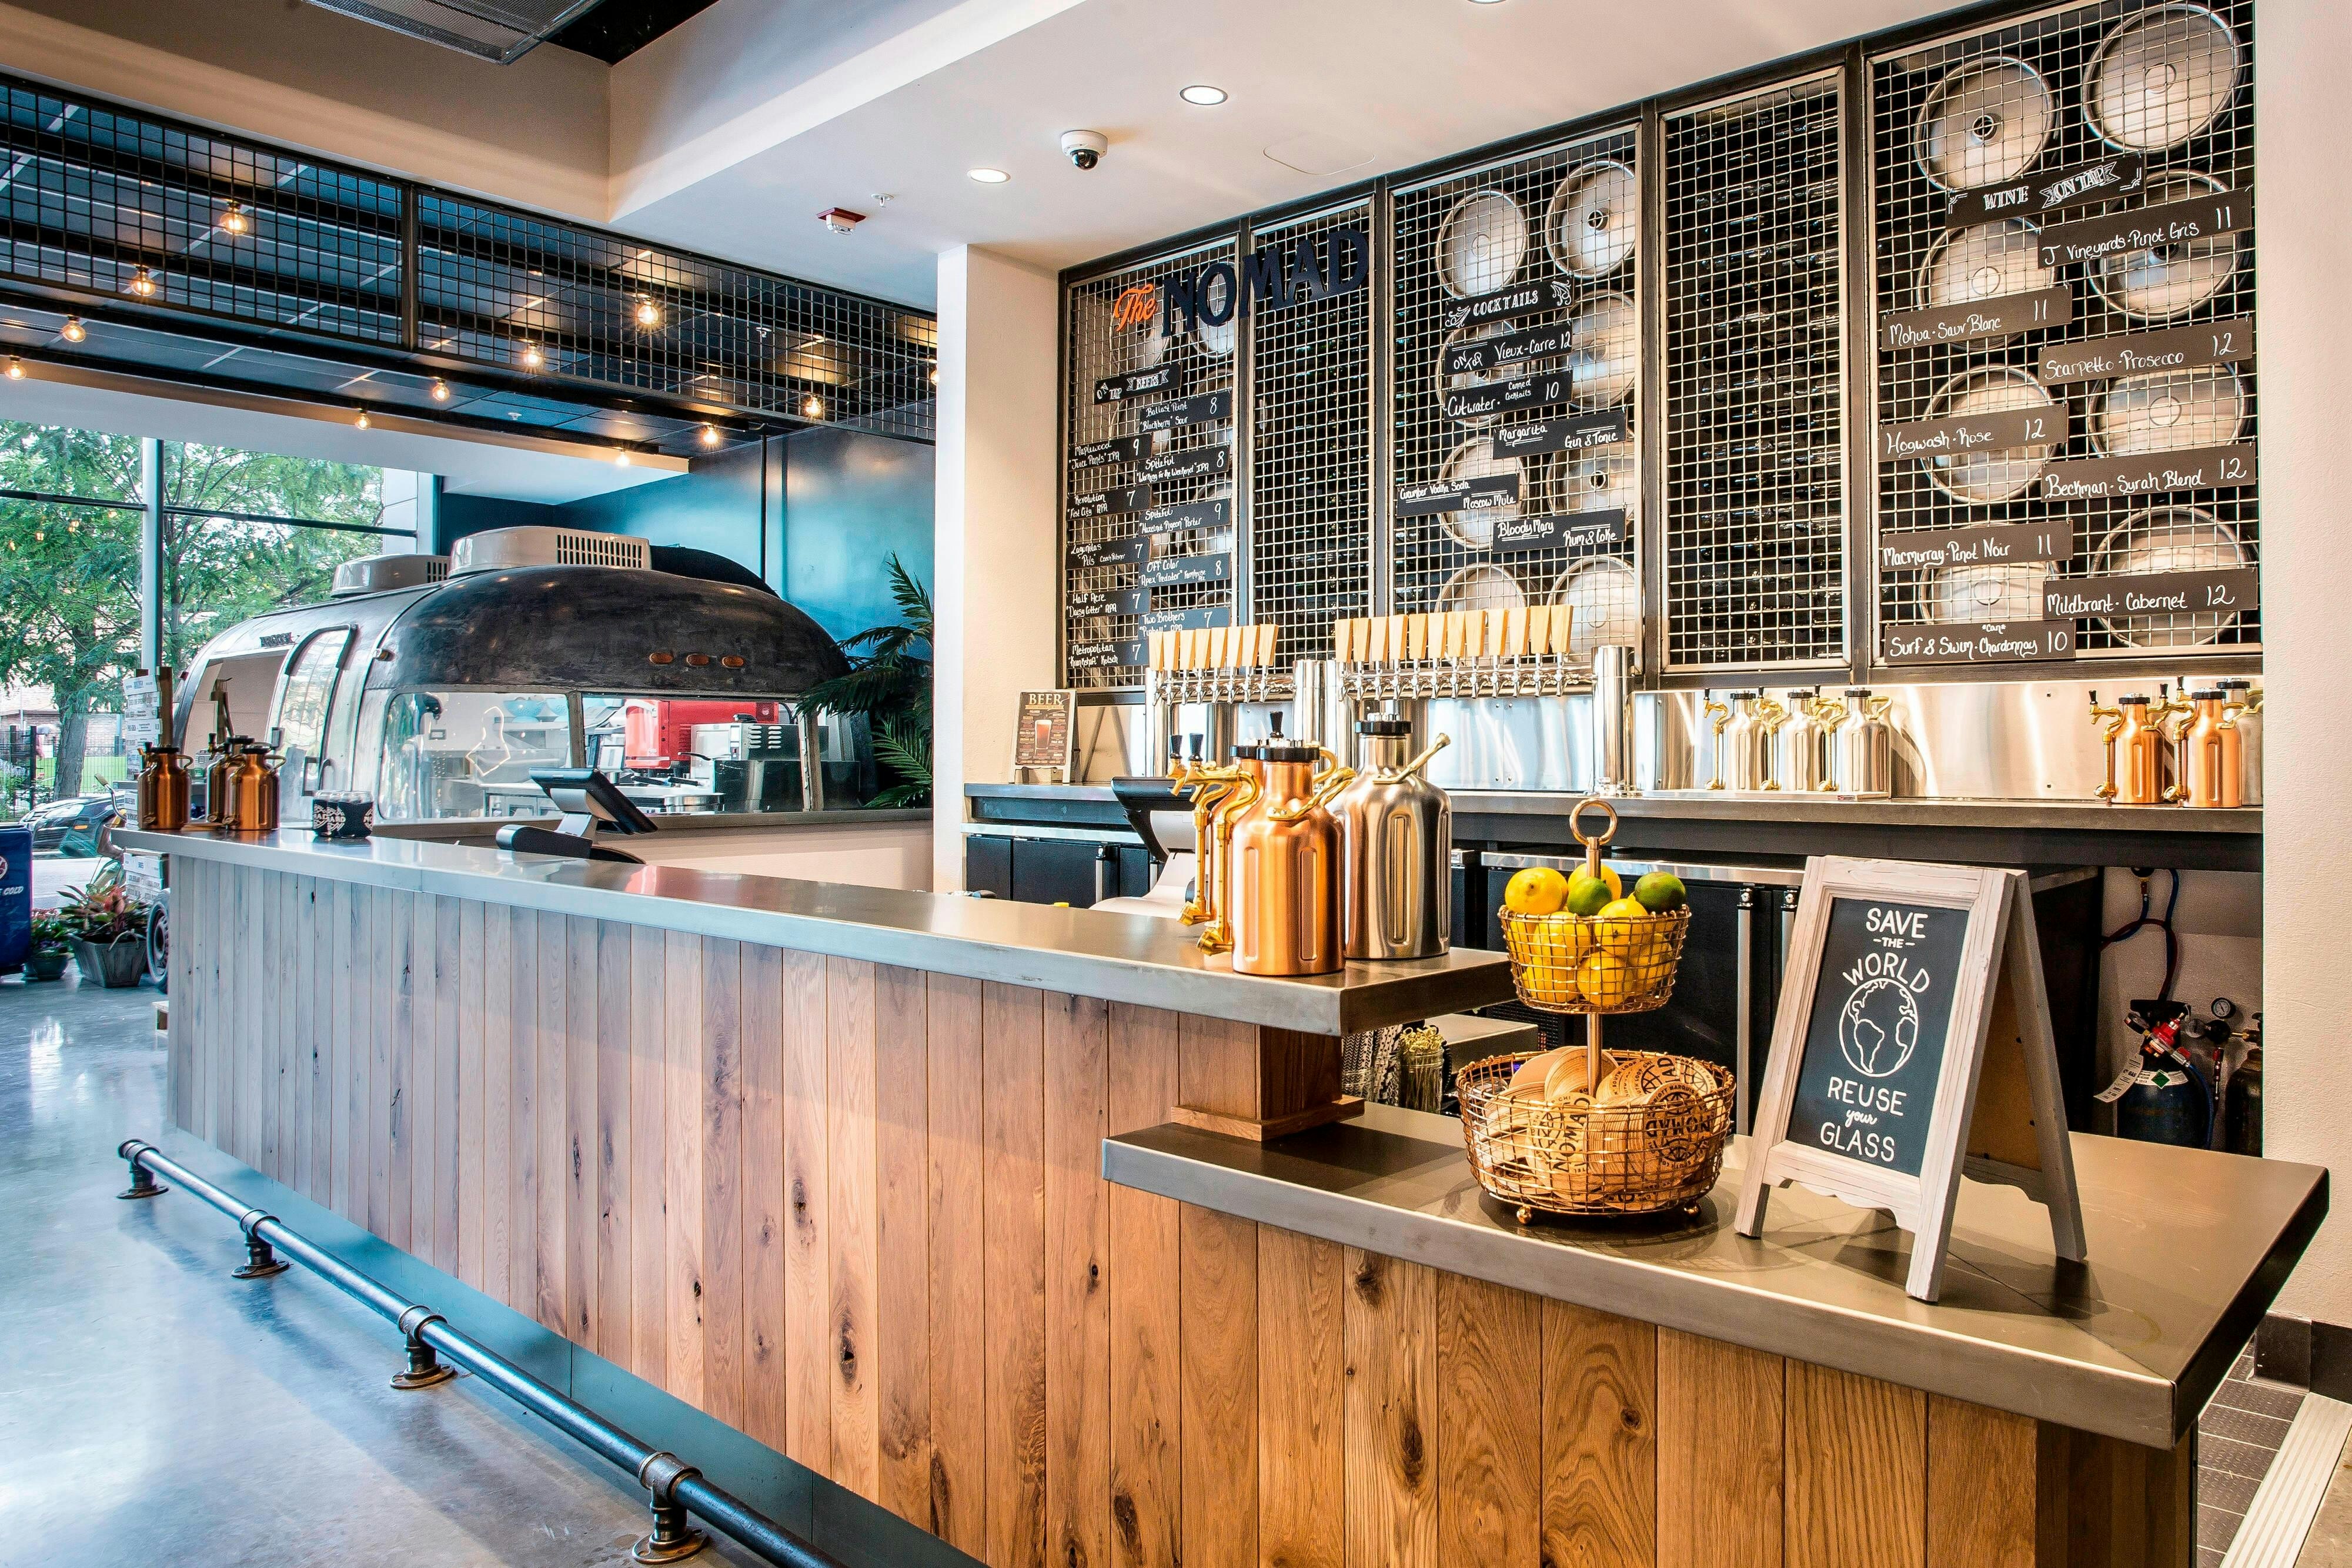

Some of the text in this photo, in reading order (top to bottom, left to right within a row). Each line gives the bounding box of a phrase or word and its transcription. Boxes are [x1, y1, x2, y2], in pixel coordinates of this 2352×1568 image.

[1983, 168, 2104, 210] WINE ON TAP
[2042, 206, 2231, 265] J Vineyards Pinot Gris 11
[1114, 230, 1369, 337] The NOMAD
[1473, 290, 1538, 316] COCKTAILS
[1890, 299, 2047, 346] Mohua Sauv Blanc 11
[1454, 350, 1466, 369] ON
[1561, 332, 1572, 348] 12
[2120, 350, 2184, 370] Prosecco
[2212, 332, 2238, 356] 12
[1097, 375, 1159, 400] ON TAP BEERS
[1508, 379, 1531, 390] Canned
[1146, 397, 1217, 418] Ballast Point 8
[1447, 382, 1559, 417] Cutwater Cocktails 10
[1175, 416, 1188, 425] Sour
[1499, 424, 1548, 444] Margarita
[1565, 435, 1582, 448] Gin
[1591, 431, 1618, 444] Tonic
[1886, 418, 2046, 458] Hogwash Rose 12
[1075, 439, 1139, 456] Maplewood 9
[1108, 451, 1120, 462] IPA
[1196, 463, 1209, 473] IPA
[1217, 451, 1224, 468] 8
[2044, 457, 2247, 499] Beckman Syrah Blend 12
[1075, 490, 1135, 506] Revolution 7
[1399, 481, 1471, 500] Cucumber Vodka Soda
[1463, 494, 1516, 509] Moscow Mule
[1215, 503, 1222, 520] 9
[1184, 517, 1202, 527] Porter
[1498, 519, 1554, 539] Bloody Mary
[1563, 530, 1585, 546] Rum
[1596, 529, 1617, 543] Coke
[1071, 543, 1143, 558] Lagunitas 7
[1947, 540, 1979, 562] Pinot
[1983, 537, 2010, 557] Noir
[2038, 534, 2052, 555] 11
[1162, 559, 1179, 570] Color
[1215, 560, 1222, 576] 8
[1073, 593, 1141, 609] Half Acre 7
[1105, 603, 1117, 613] APA
[2047, 585, 2235, 616] Mildbrant Cabernet 12
[1141, 611, 1212, 628] Two Brothers 7
[1073, 643, 1141, 660] Metropolitan 7
[1890, 636, 1923, 657] Surf
[1939, 636, 1975, 660] Swim
[1979, 637, 2037, 658] Chardonnay
[2048, 631, 2067, 653] 10
[1029, 694, 1063, 705] BEER
[1866, 907, 1929, 939] SAVE
[1882, 937, 1904, 949] THE
[1843, 952, 1930, 994] WORLD
[1828, 1077, 1907, 1116] REUSE
[1845, 1109, 1877, 1128] your
[1820, 1122, 1895, 1162] GLASS
